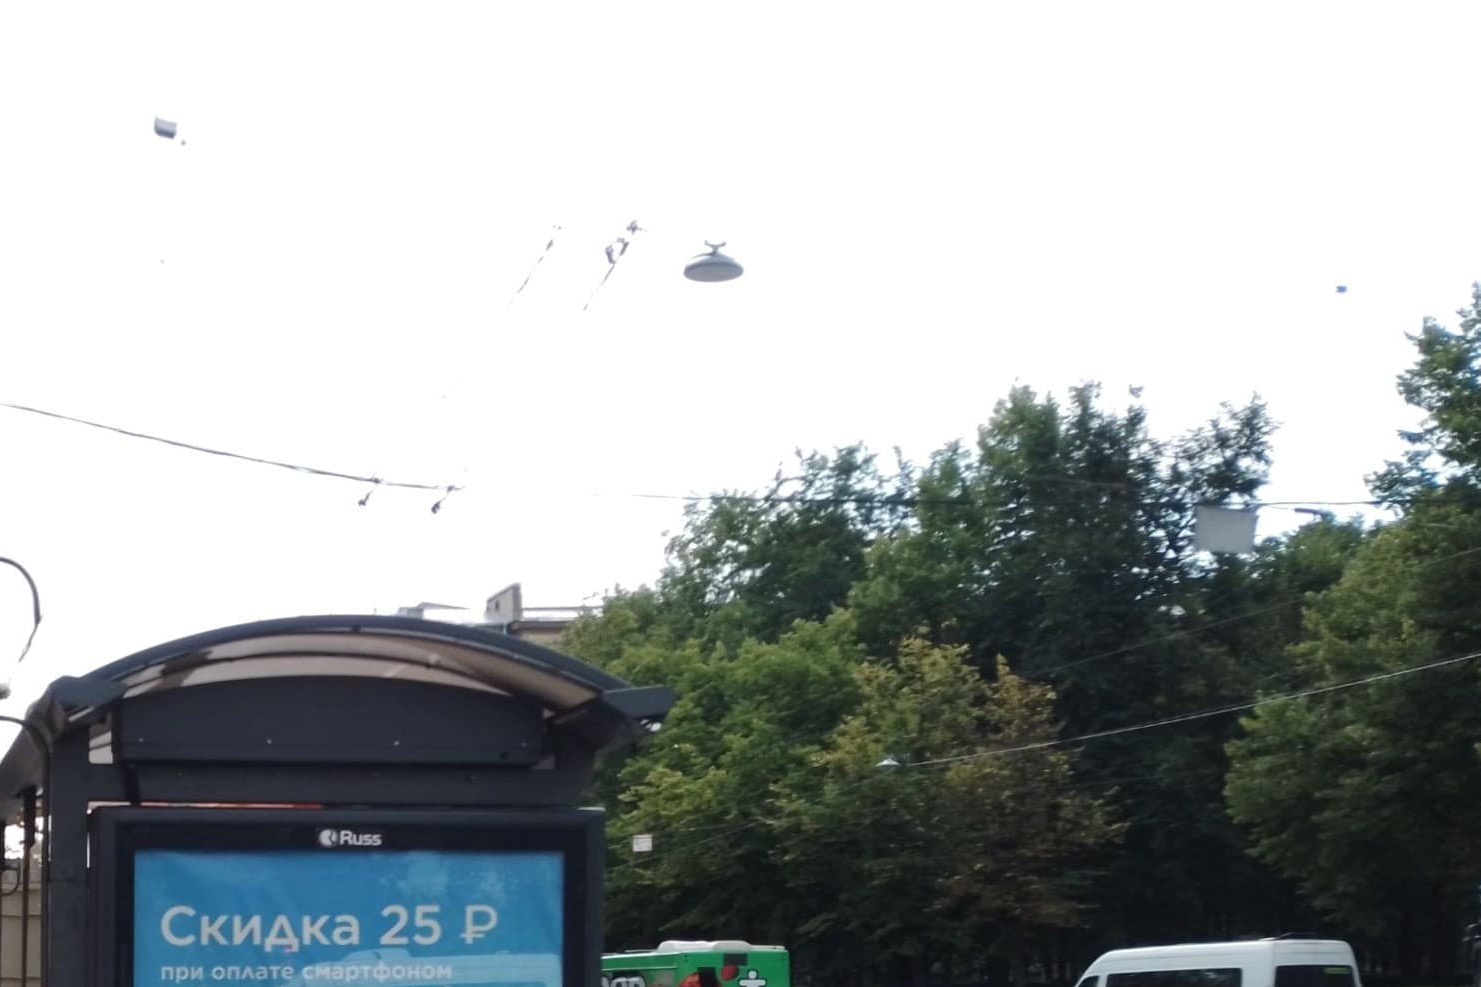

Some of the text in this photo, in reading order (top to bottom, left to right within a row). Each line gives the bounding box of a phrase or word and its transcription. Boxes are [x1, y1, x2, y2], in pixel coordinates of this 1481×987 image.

[340, 830, 382, 846] Russ
[160, 905, 360, 953] Скидка
[379, 904, 441, 945] 25
[160, 961, 453, 984] при оплате смартфоном
